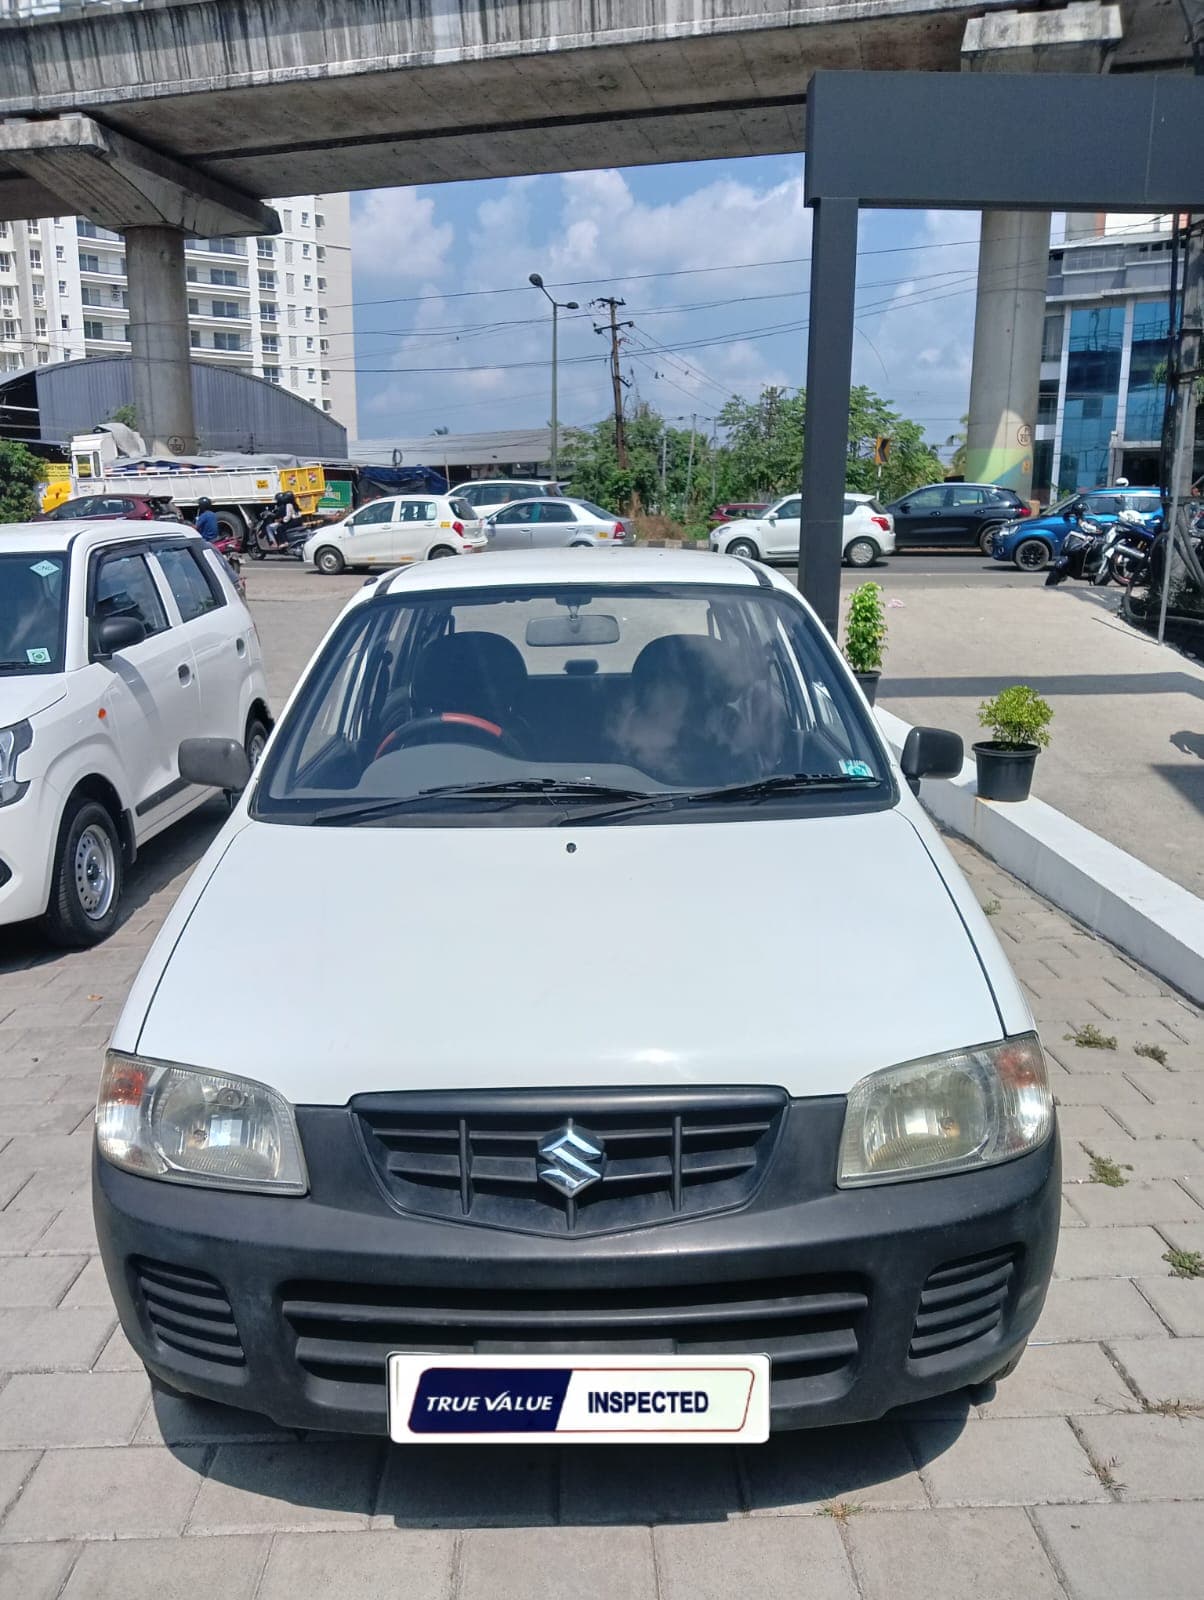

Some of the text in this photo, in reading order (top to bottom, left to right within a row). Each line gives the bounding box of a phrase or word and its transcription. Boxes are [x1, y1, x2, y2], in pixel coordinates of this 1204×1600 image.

[426, 1390, 709, 1414] TRUE VALUE INSPECTED
